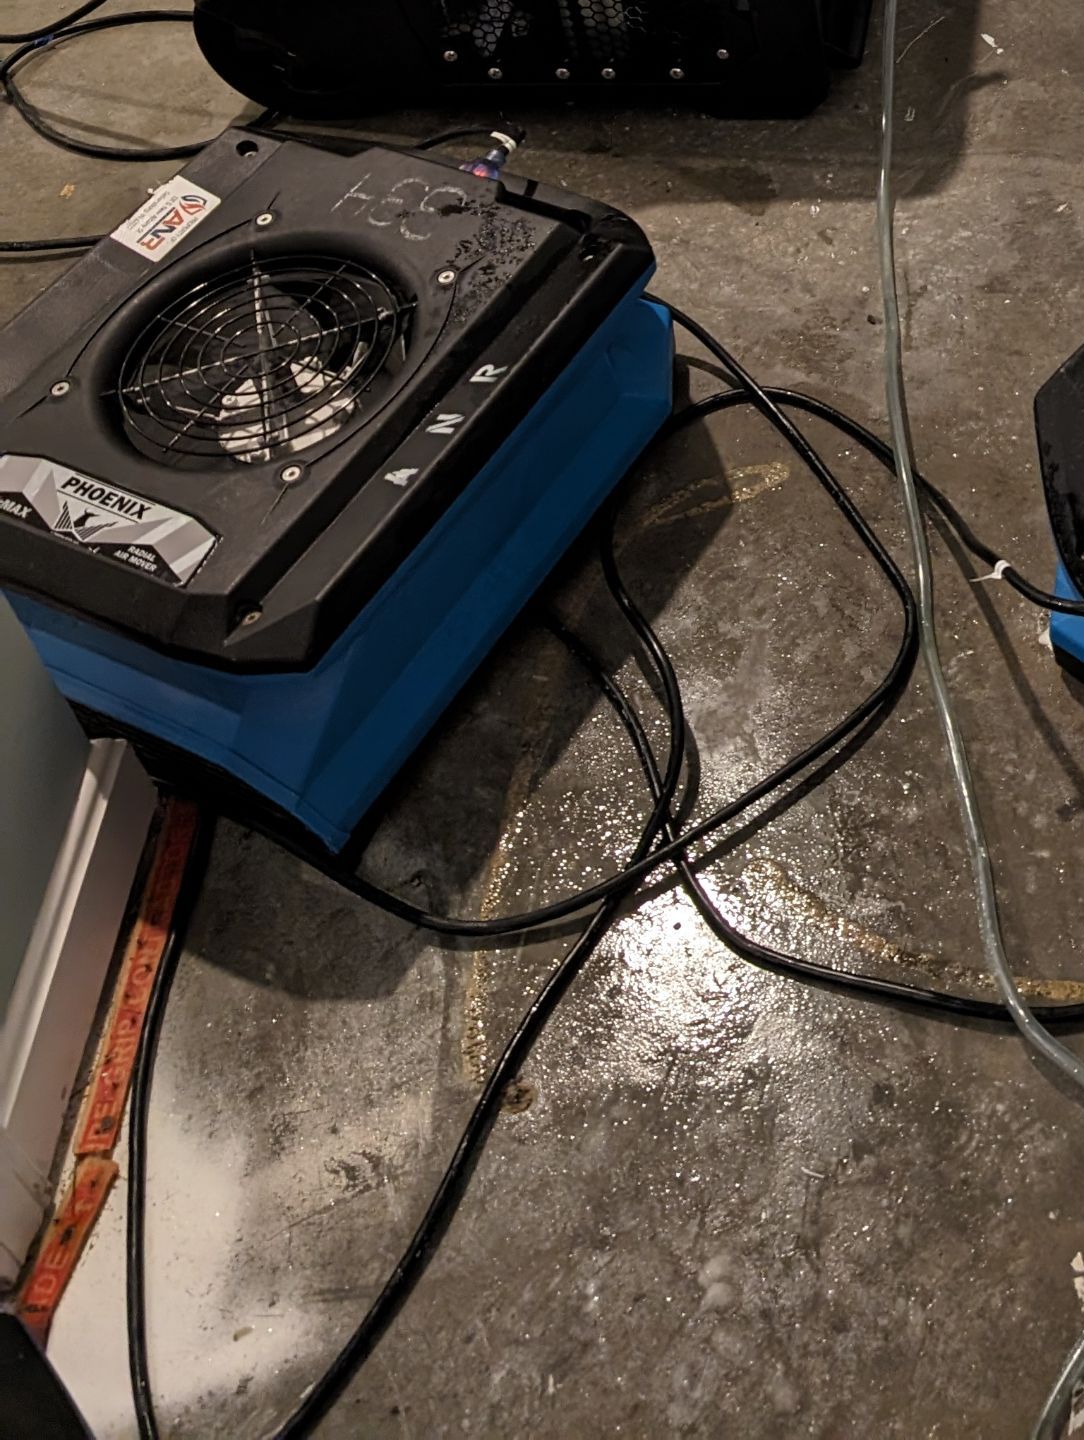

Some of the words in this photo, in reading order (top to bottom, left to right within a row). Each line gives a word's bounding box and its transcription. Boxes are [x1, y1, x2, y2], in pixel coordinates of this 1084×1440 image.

[140, 208, 185, 252] ANR
[61, 475, 152, 521] PHOENIX
[114, 549, 130, 562] AIR
[129, 554, 158, 573] MOVER
[127, 545, 157, 562] RADIAL
